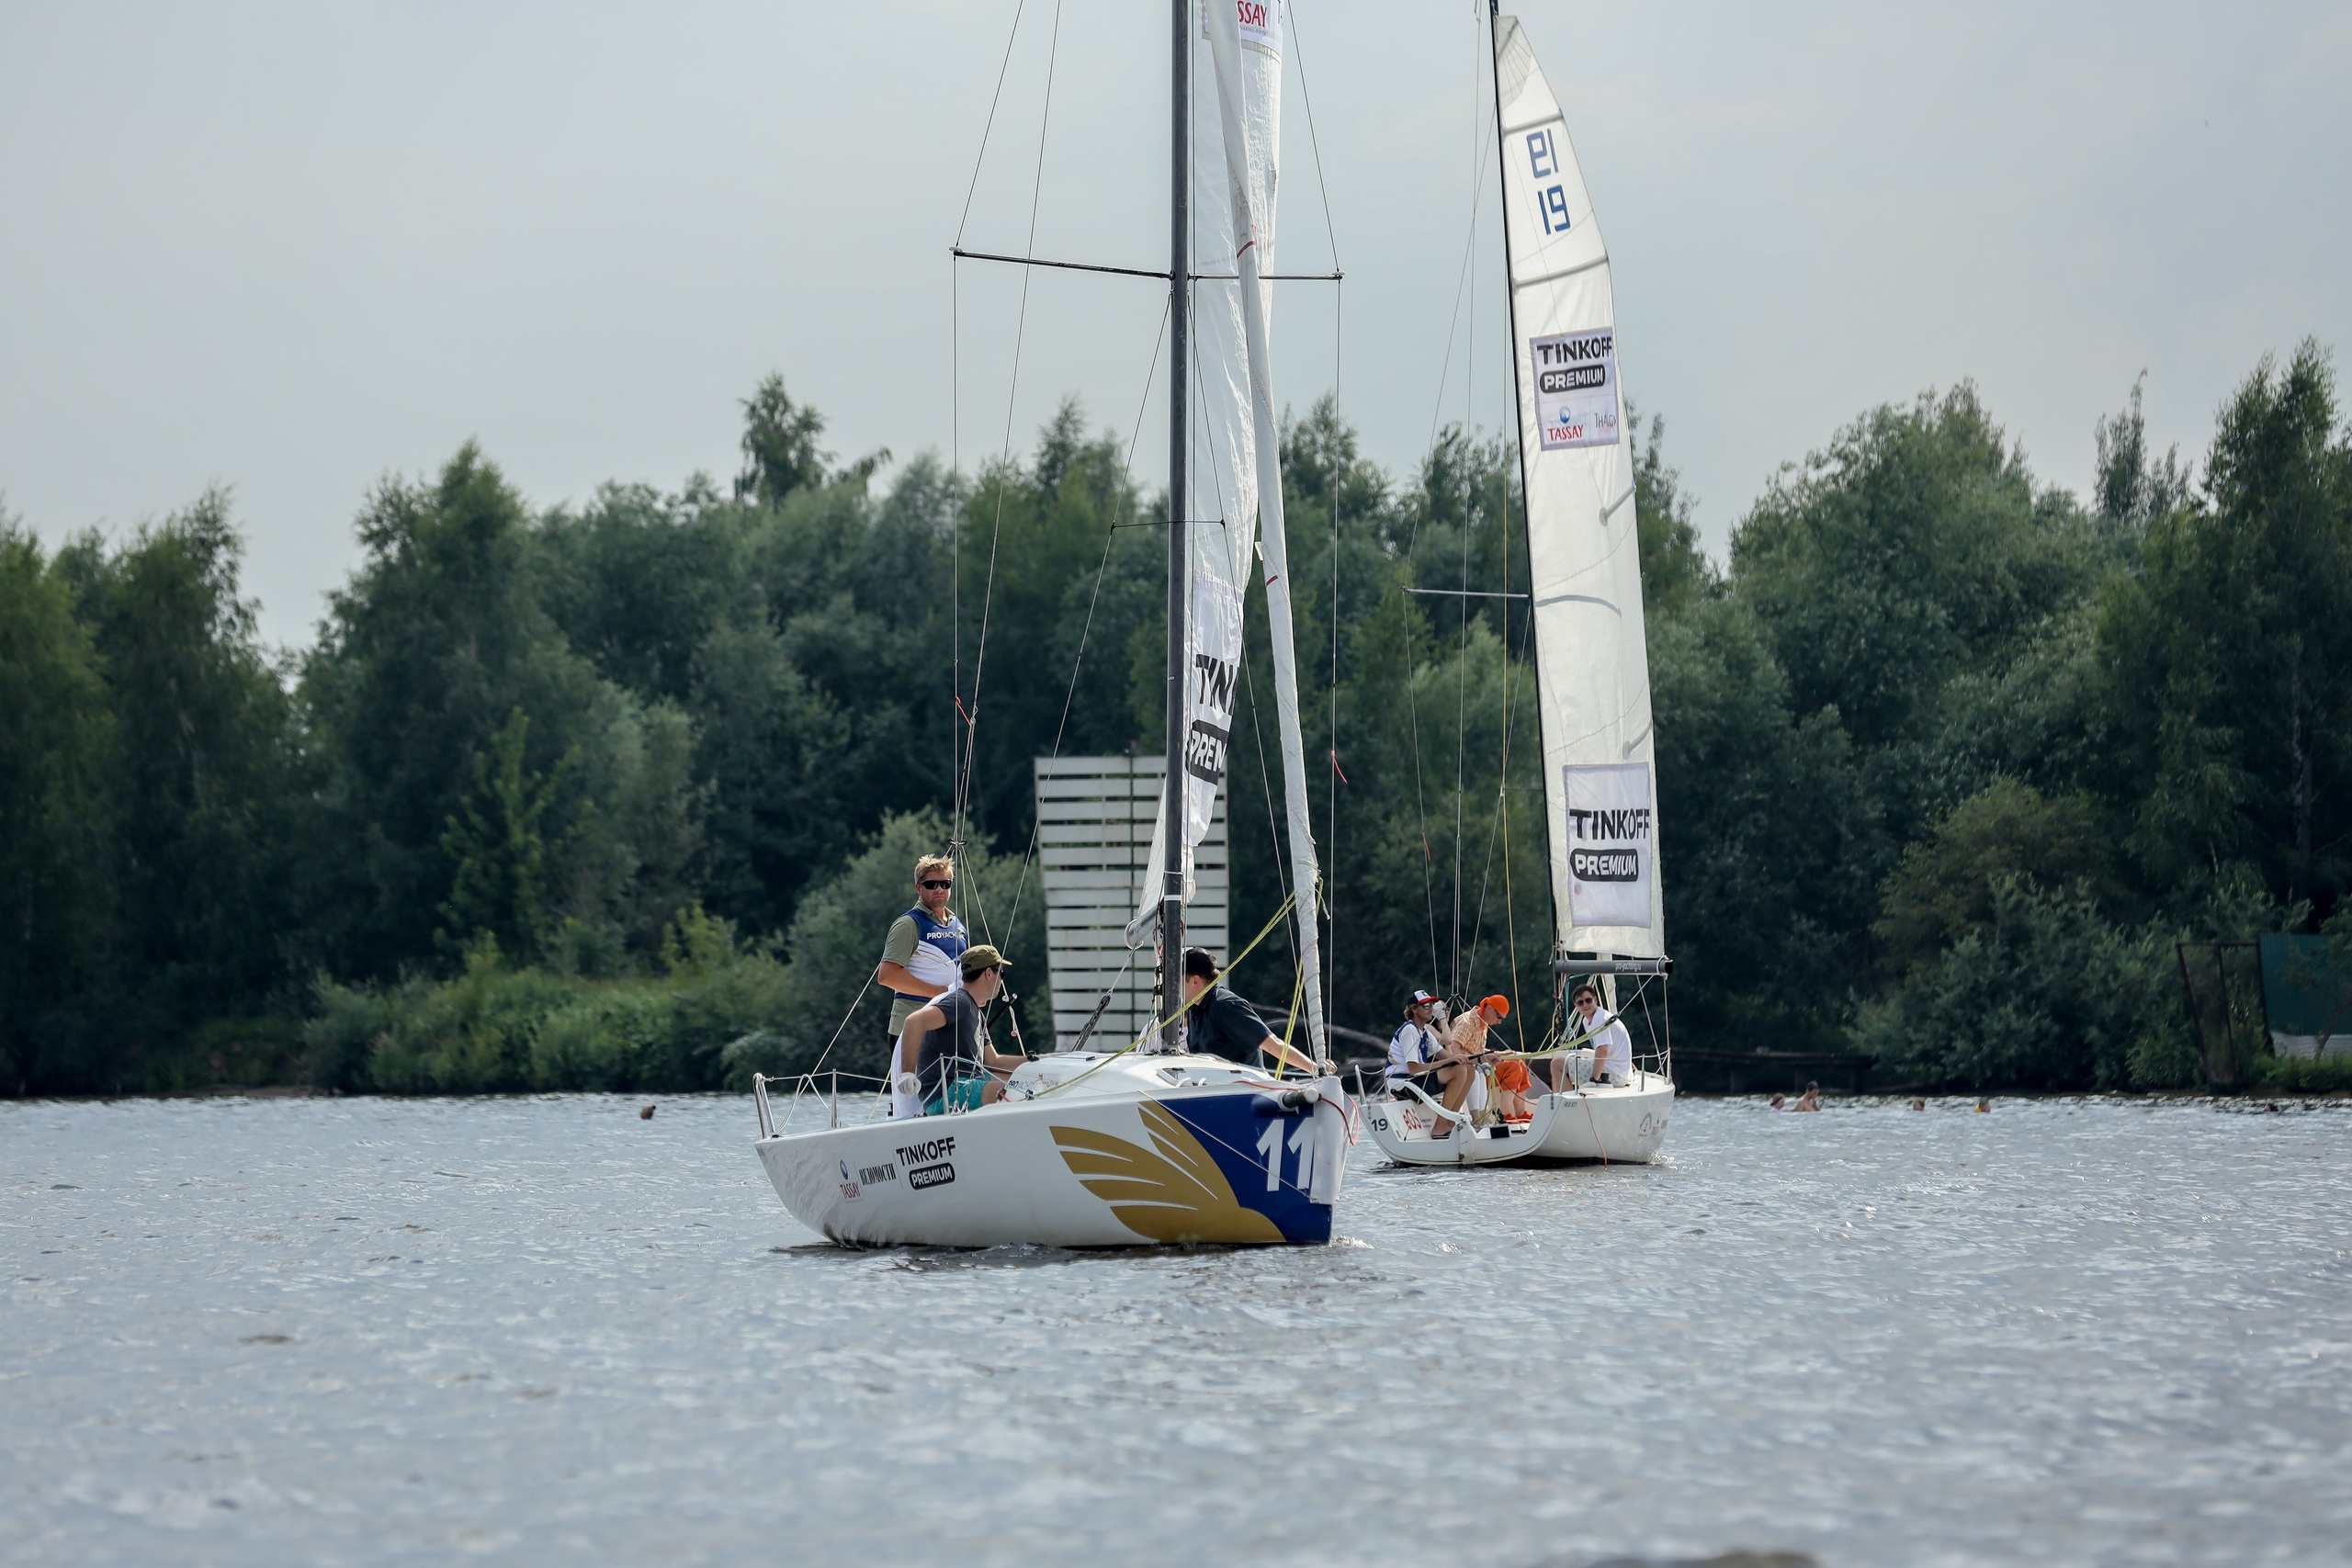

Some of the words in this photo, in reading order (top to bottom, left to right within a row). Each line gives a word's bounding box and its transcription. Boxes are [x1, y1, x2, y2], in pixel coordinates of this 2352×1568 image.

[1237, 0, 1267, 28] SSAY
[1537, 184, 1571, 235] 19
[1536, 336, 1612, 365] TINKOFF
[1544, 367, 1604, 390] PREMIUM
[1547, 424, 1584, 441] TASSAY
[1569, 808, 1650, 840] TINKOFF
[1575, 853, 1637, 876] PREMIUM
[1371, 1118, 1388, 1132] 19
[896, 1136, 956, 1167] TINKOFF
[1256, 1116, 1315, 1192] 11
[910, 1166, 953, 1187] PREMIUM
[839, 1181, 861, 1199] TASSAY
